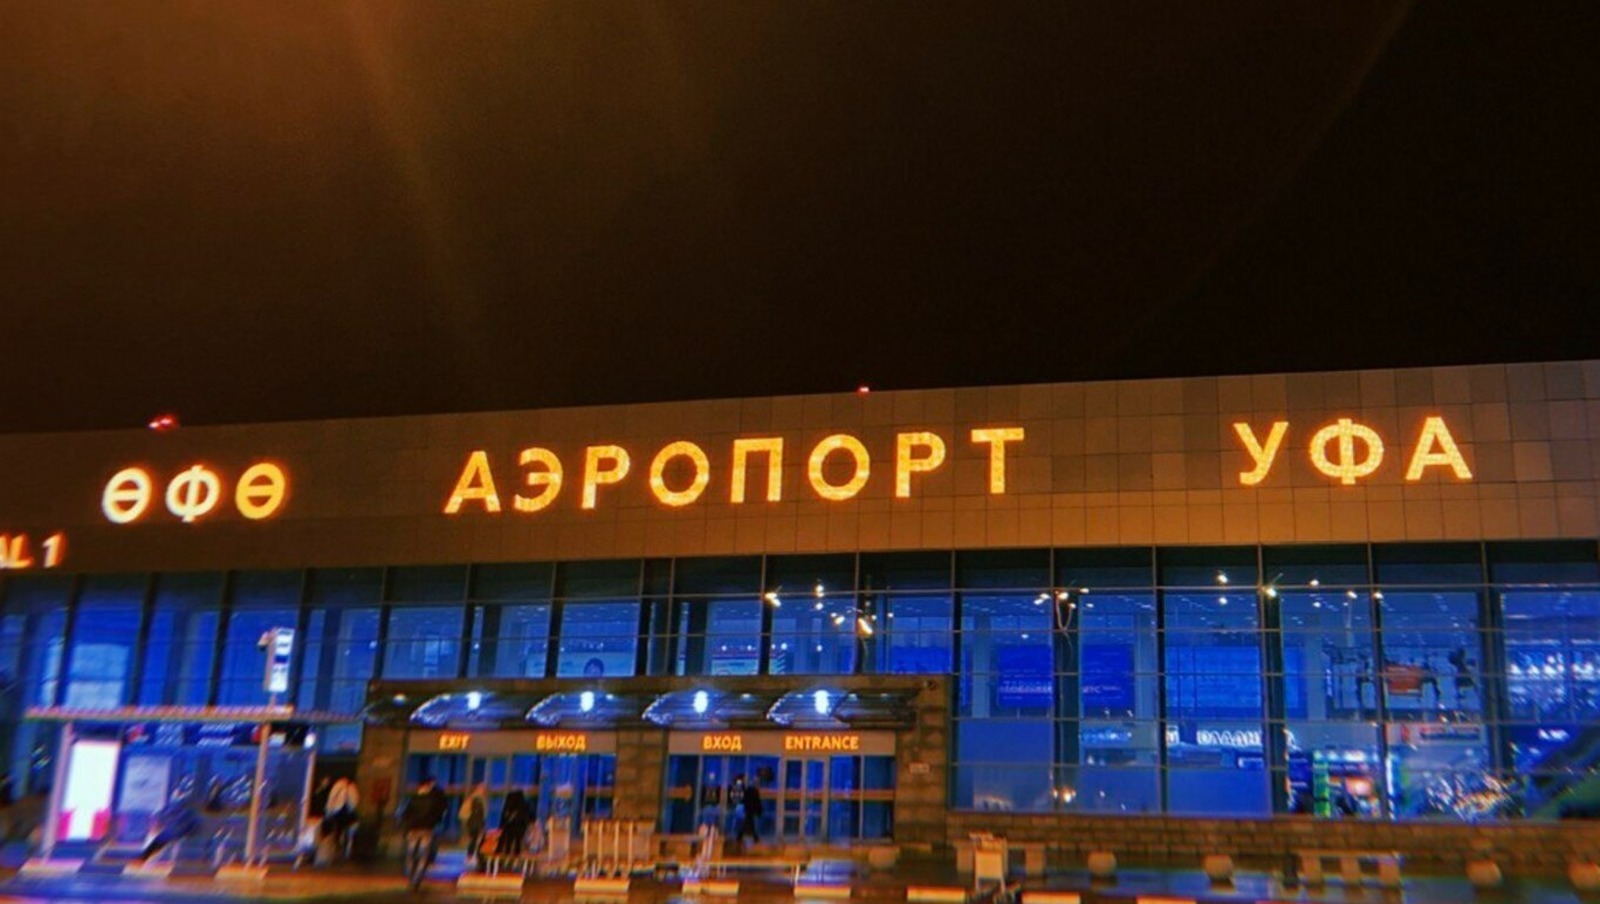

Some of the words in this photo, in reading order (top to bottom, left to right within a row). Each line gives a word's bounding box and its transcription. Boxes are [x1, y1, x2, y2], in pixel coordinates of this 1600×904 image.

[443, 426, 1025, 514] АЭРОПОРТ
[1233, 416, 1473, 486] УФА
[439, 733, 471, 750] EXIT
[536, 734, 587, 752] ВЫХОД
[702, 734, 743, 752] ВХОД
[785, 735, 860, 751] ENTRANCE
